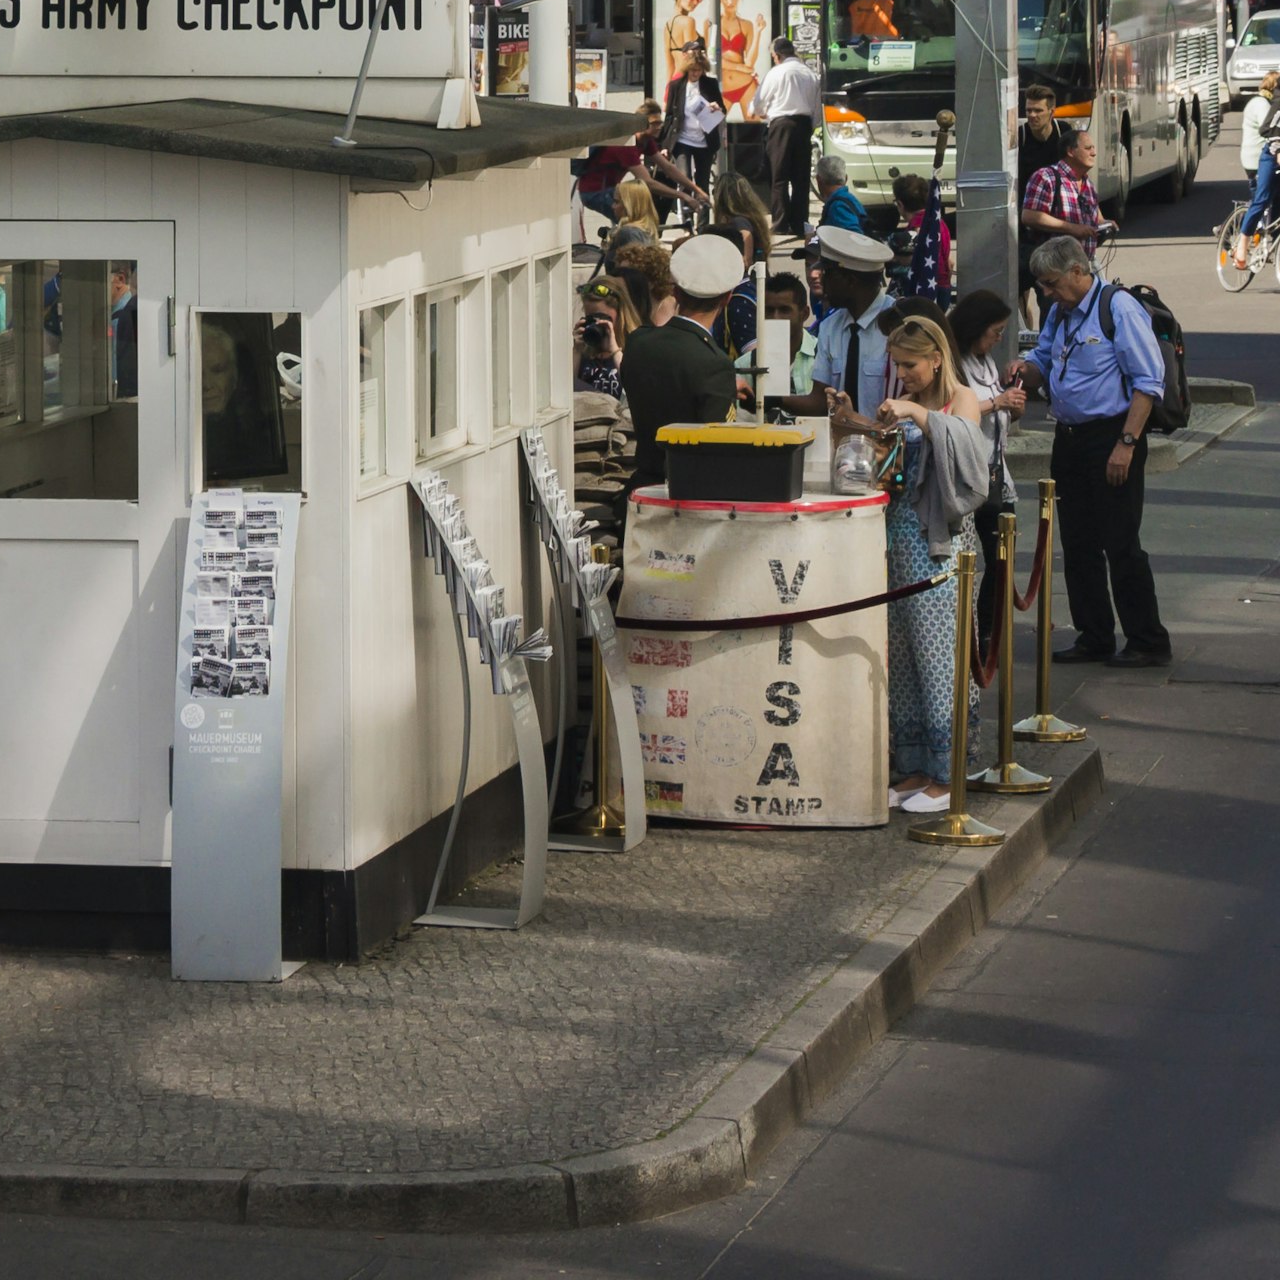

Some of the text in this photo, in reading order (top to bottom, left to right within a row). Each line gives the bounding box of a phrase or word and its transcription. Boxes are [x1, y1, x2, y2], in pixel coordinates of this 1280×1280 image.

[872, 55, 880, 66] 8
[756, 559, 810, 787] VISA
[188, 732, 262, 744] MAUERMUSEUM
[188, 745, 262, 753] CHECKPOINT CHARLIE
[733, 795, 823, 816] STAMP
